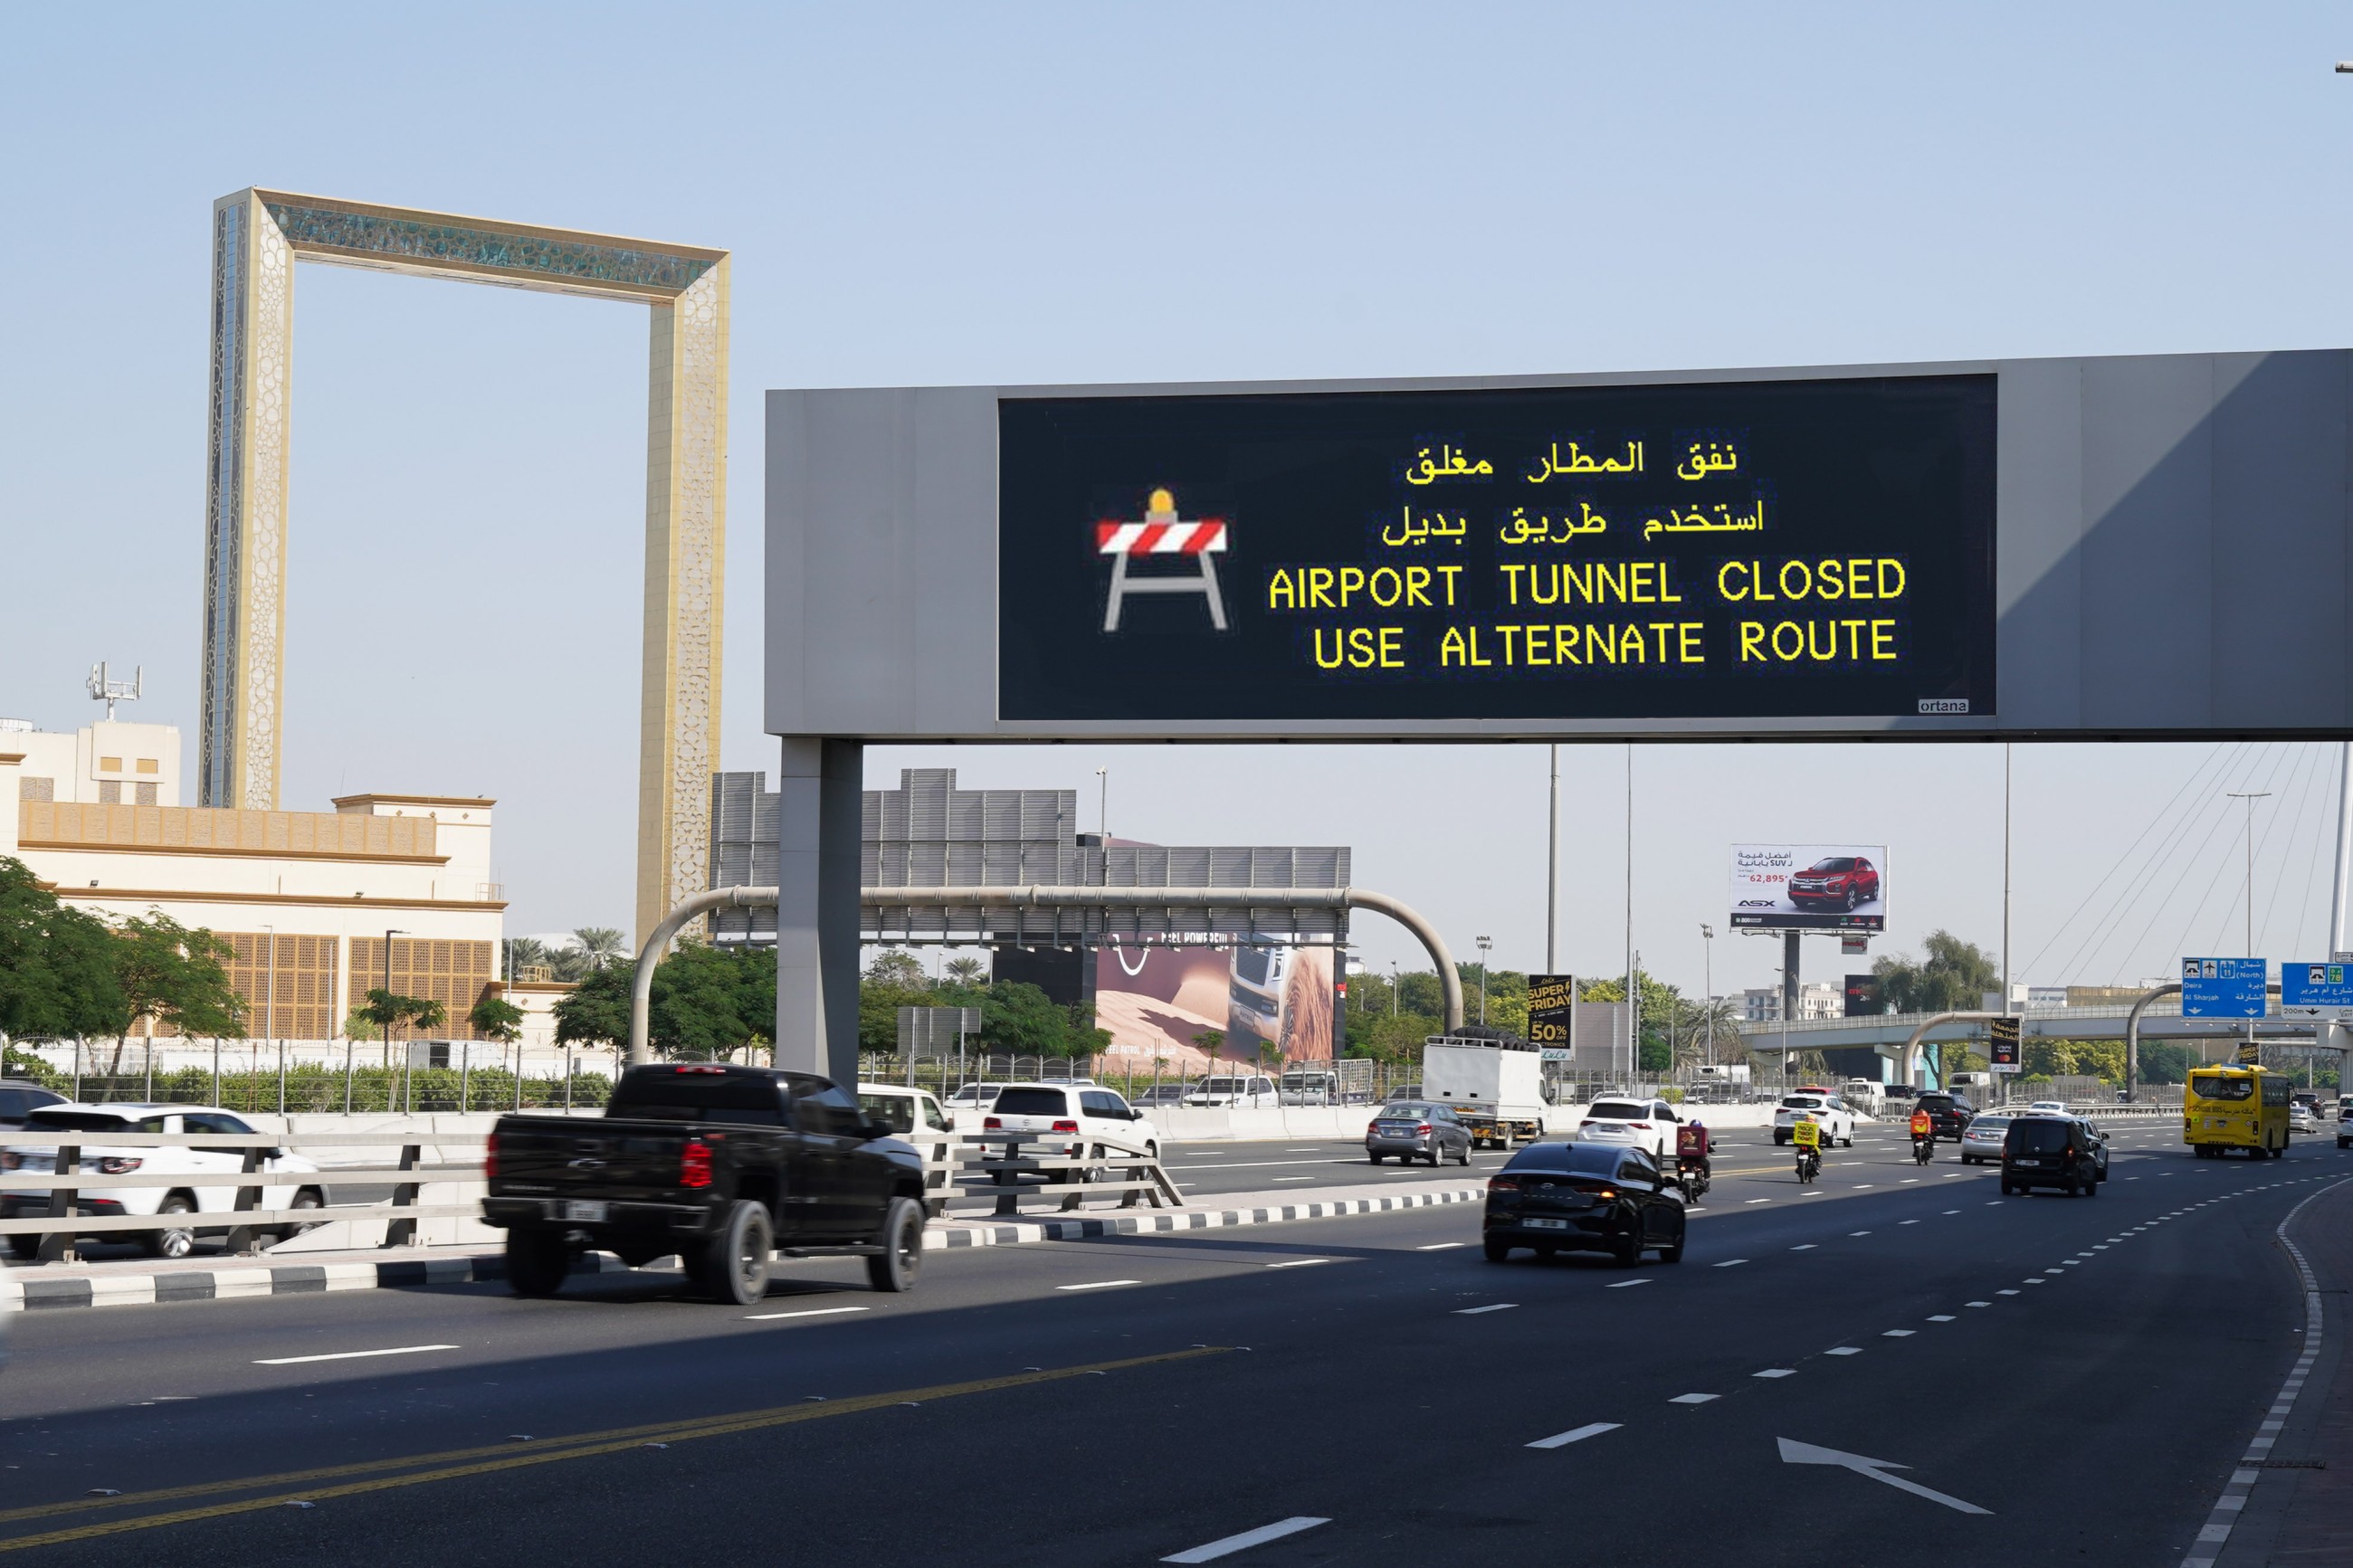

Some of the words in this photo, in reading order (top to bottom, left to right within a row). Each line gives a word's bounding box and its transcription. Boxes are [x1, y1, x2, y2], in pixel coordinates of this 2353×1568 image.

[1406, 444, 1493, 485] مغلق
[1528, 442, 1643, 483] المطار
[1678, 443, 1737, 480] نفق
[1500, 503, 1606, 545] طريق
[1644, 499, 1763, 542] استخدم
[1383, 506, 1466, 546] بديل
[1271, 566, 1463, 609] AIRPORT
[1500, 563, 1681, 604] TUNNEL
[1719, 558, 1906, 601] CLOSED
[1315, 628, 1405, 669] USE
[1442, 622, 1705, 667] ALTERNATE
[1741, 620, 1897, 661] ROUTE
[1920, 700, 1967, 711] ortana
[1738, 851, 1764, 860] قيمة
[1765, 851, 1792, 860] أفضل
[1738, 859, 1769, 868] يابانية
[1738, 899, 1776, 908] ASX
[2235, 972, 2264, 980] (North)
[2248, 982, 2264, 990] ديرة
[2332, 986, 2353, 995] شارع
[1529, 984, 1564, 1000] SUPER
[1529, 993, 1571, 1012] FRIDAY
[2193, 993, 2220, 1002] Sharjah
[2235, 993, 2264, 1002] الشارقة
[1541, 1050, 1567, 1060] LuLu
[2192, 1105, 2211, 1113] SCHOOL
[2212, 1106, 2223, 1114] BUS
